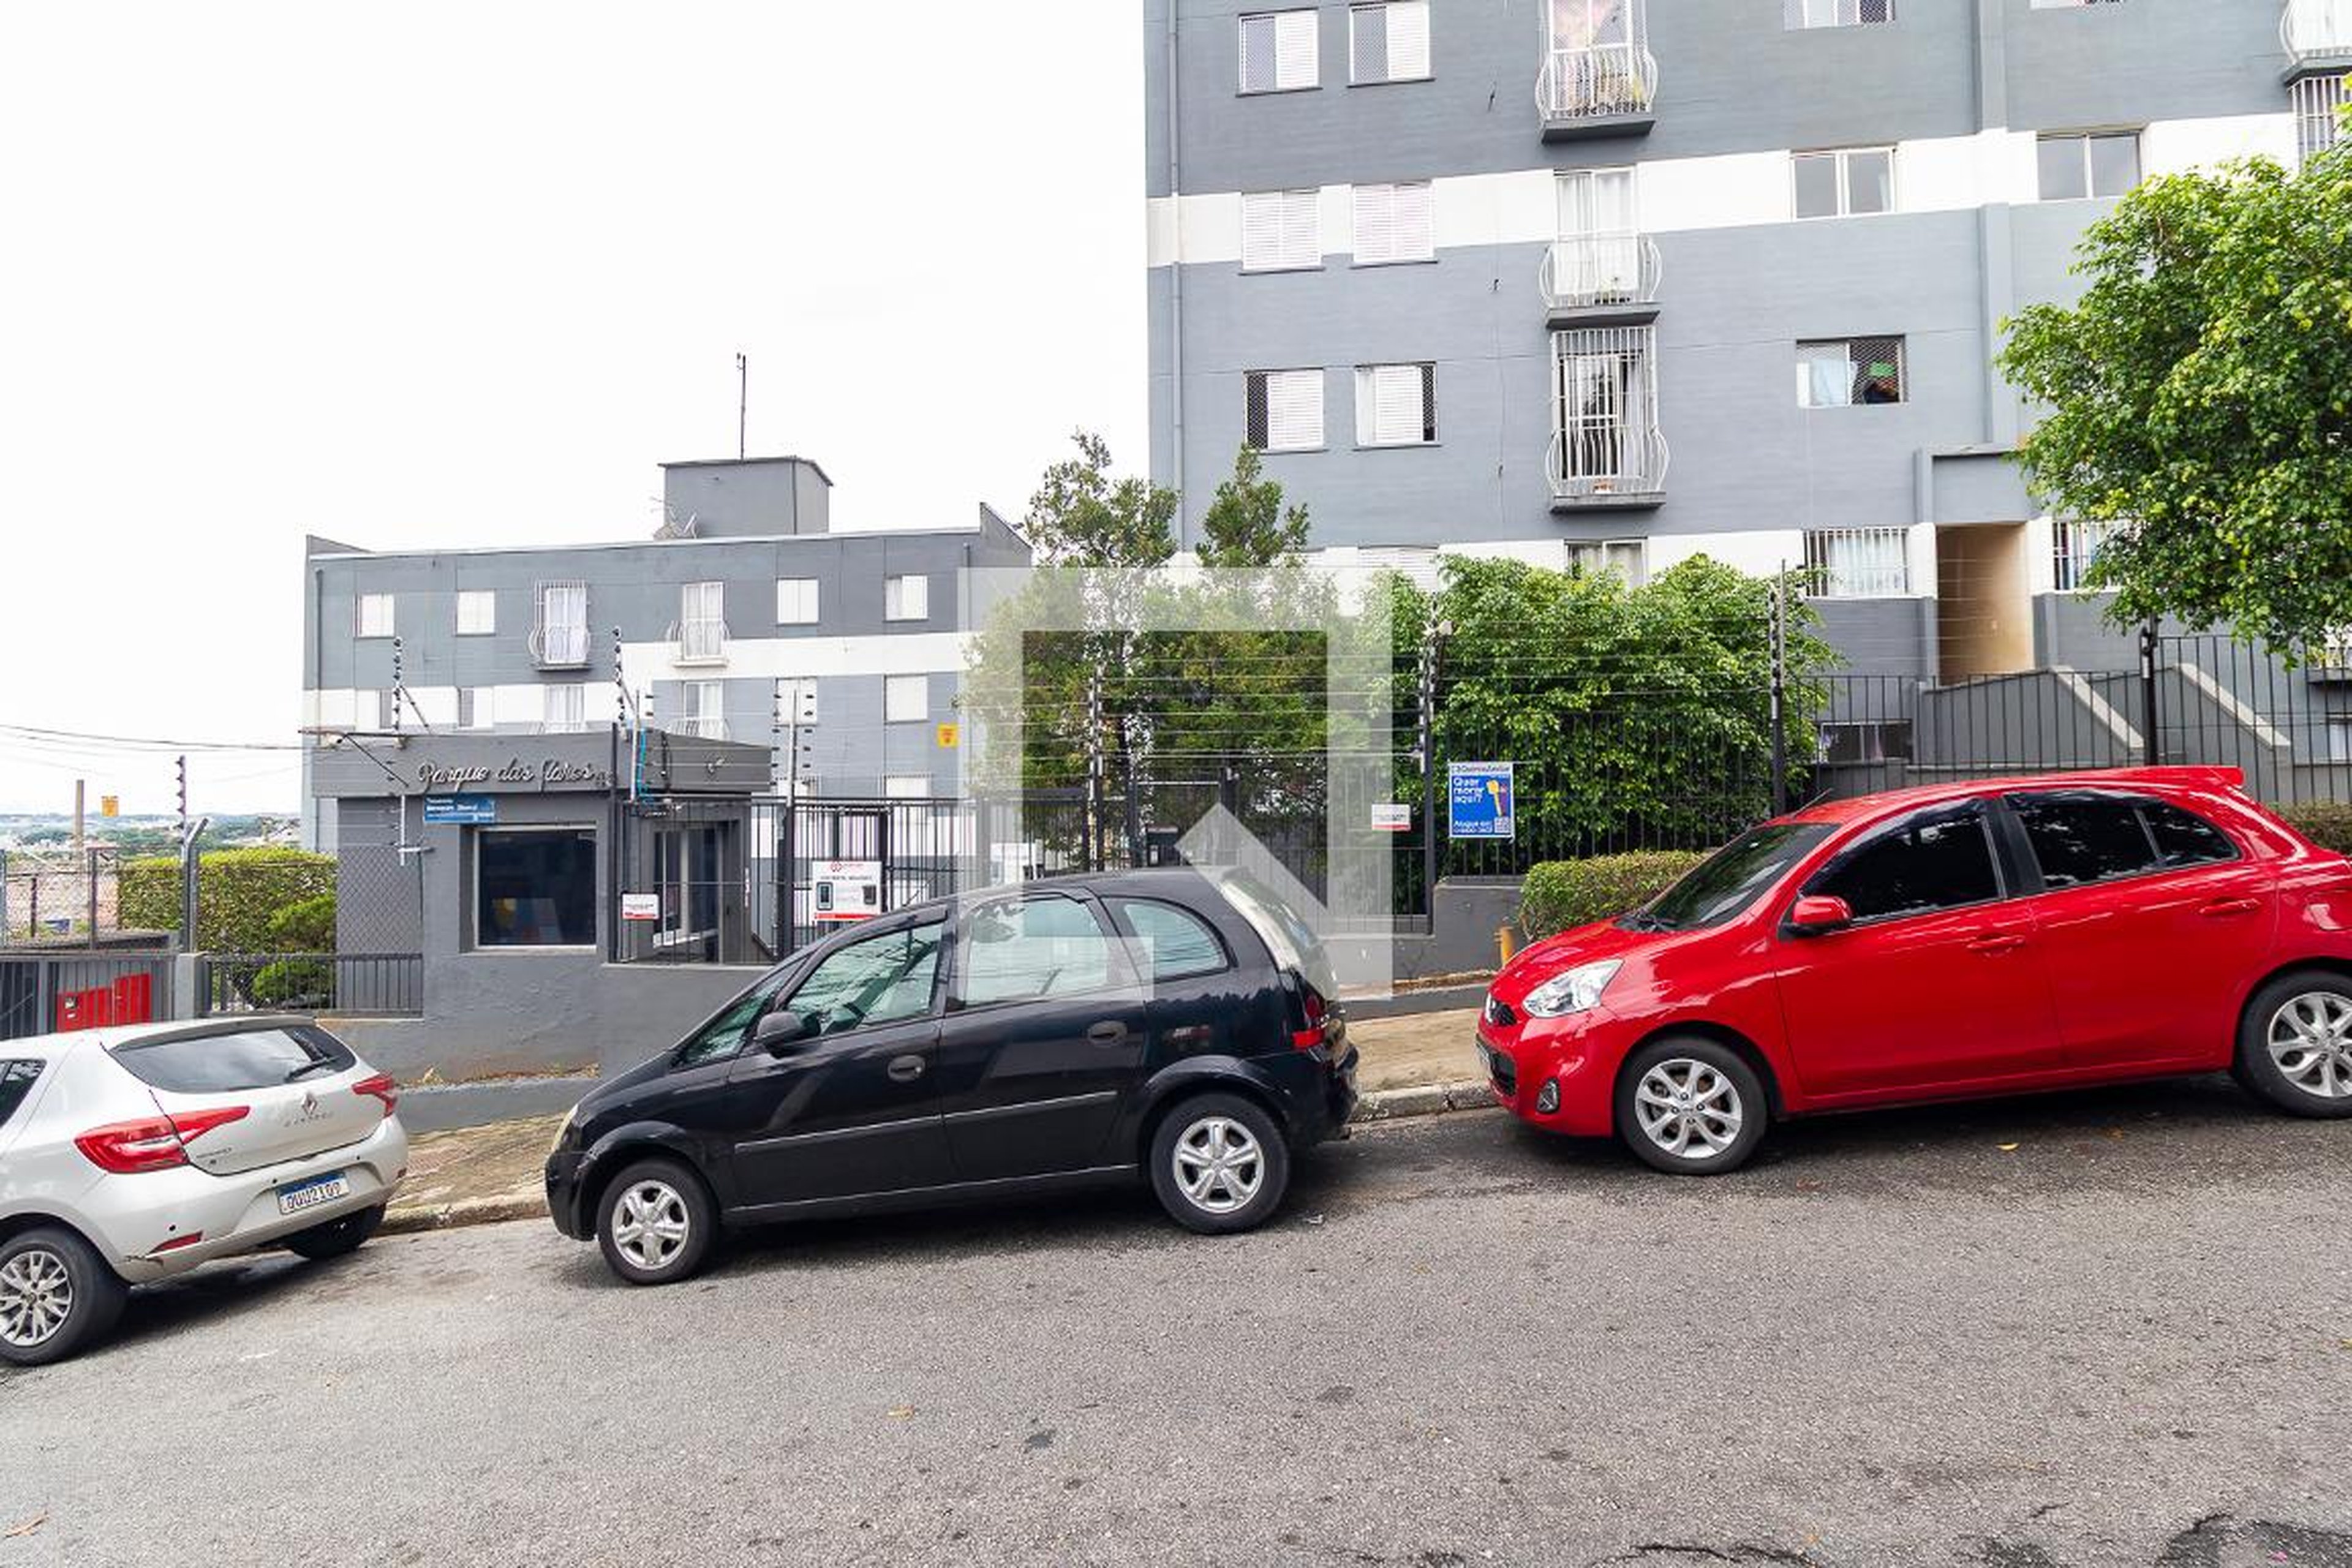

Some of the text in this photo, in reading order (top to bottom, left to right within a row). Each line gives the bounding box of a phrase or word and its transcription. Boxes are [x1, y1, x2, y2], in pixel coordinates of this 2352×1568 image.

[418, 763, 489, 796] Parque
[496, 757, 535, 783] das
[1453, 777, 1479, 787] Quer
